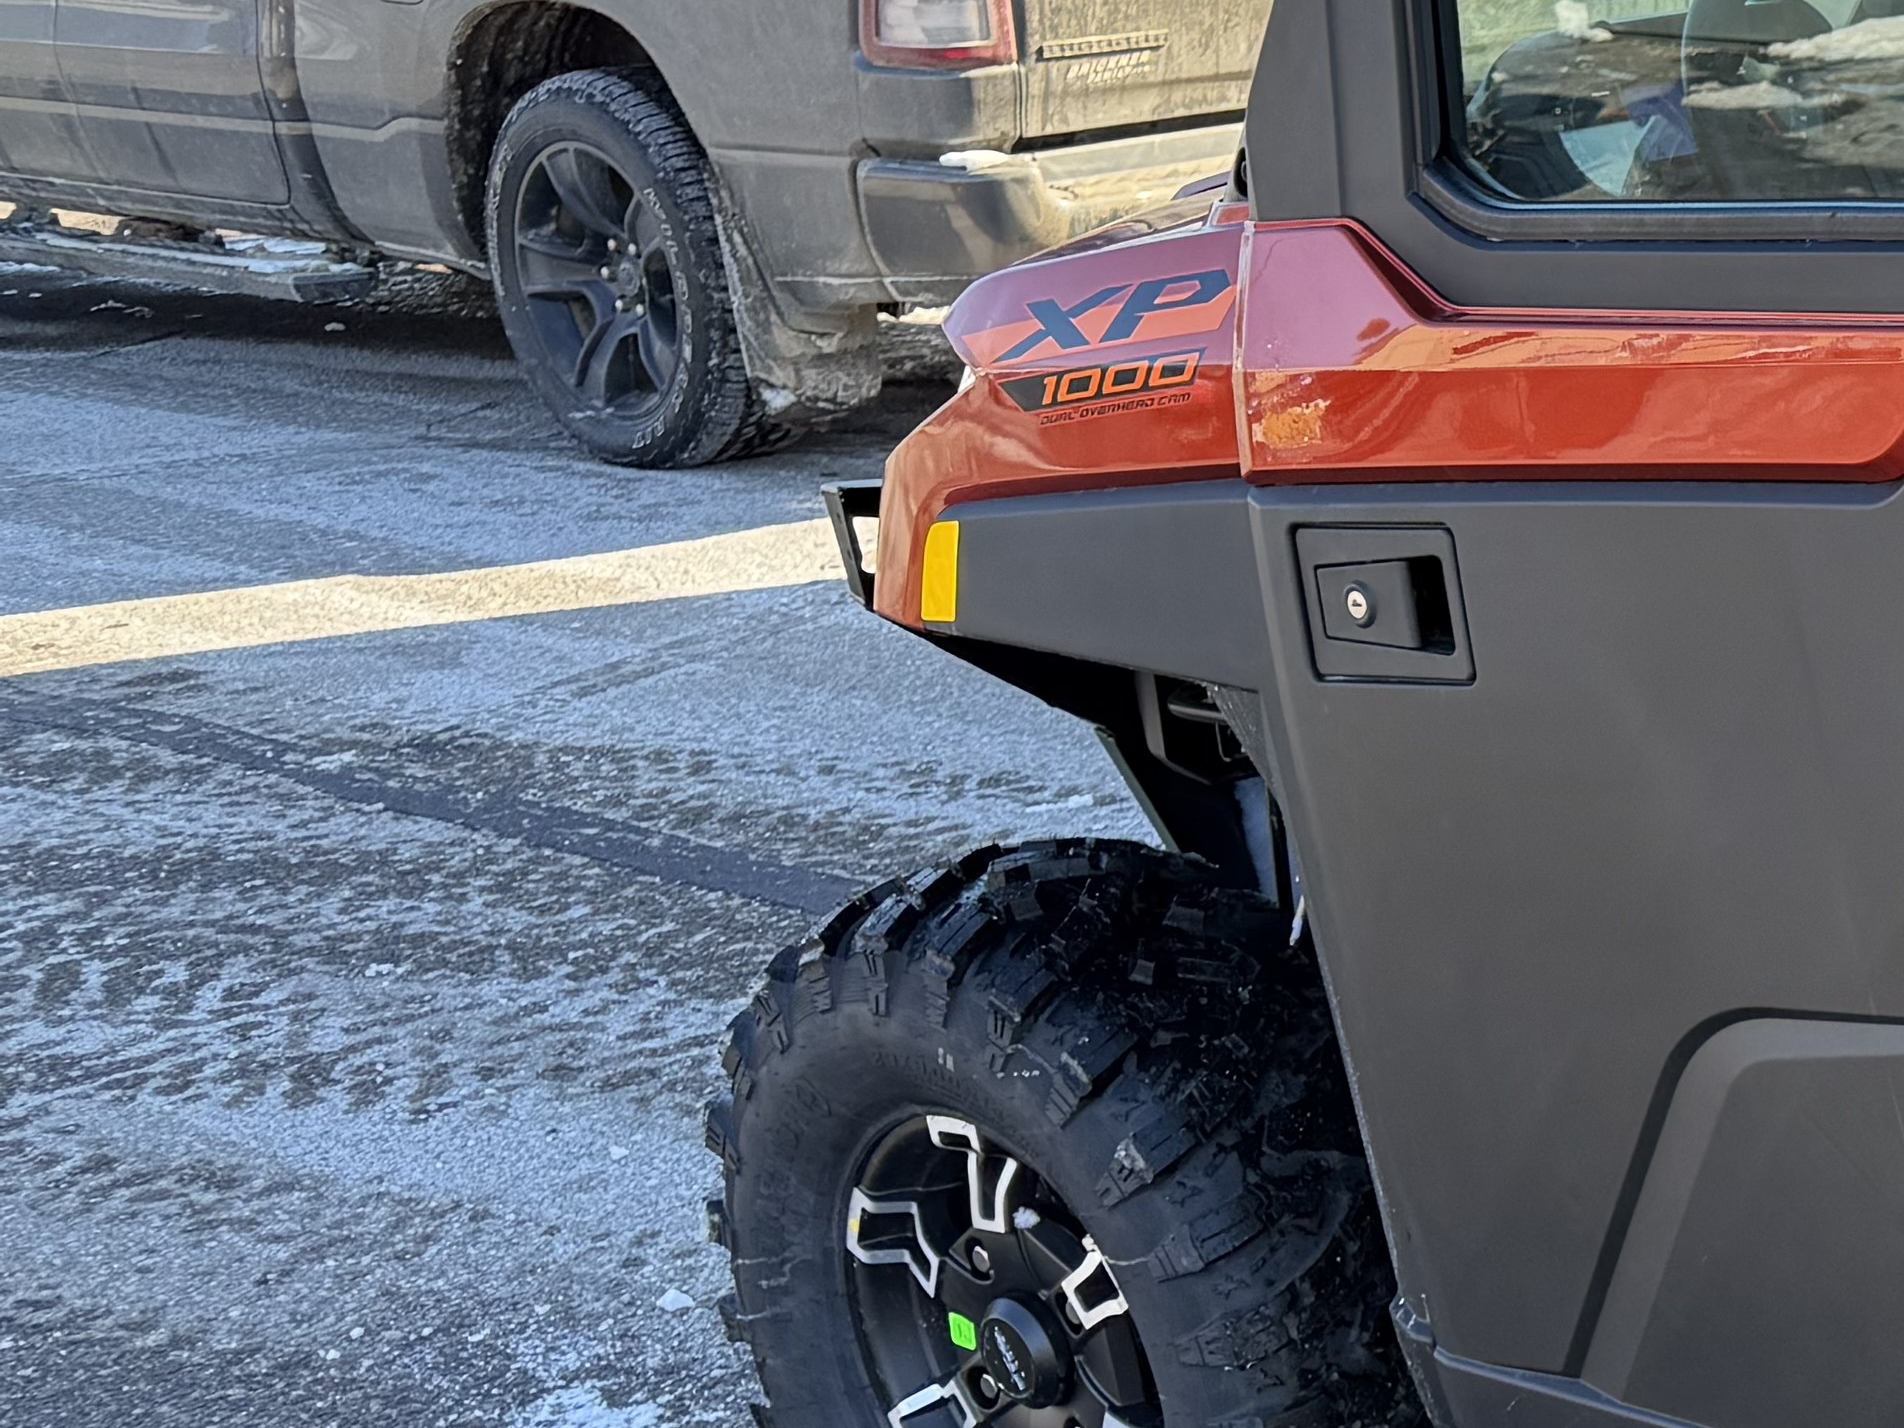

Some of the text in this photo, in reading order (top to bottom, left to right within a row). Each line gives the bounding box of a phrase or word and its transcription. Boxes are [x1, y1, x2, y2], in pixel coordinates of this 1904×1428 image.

[989, 268, 1232, 364] XP
[1041, 351, 1201, 407] 1000
[1040, 391, 1191, 426] DUAL OVERHEAD CAM
